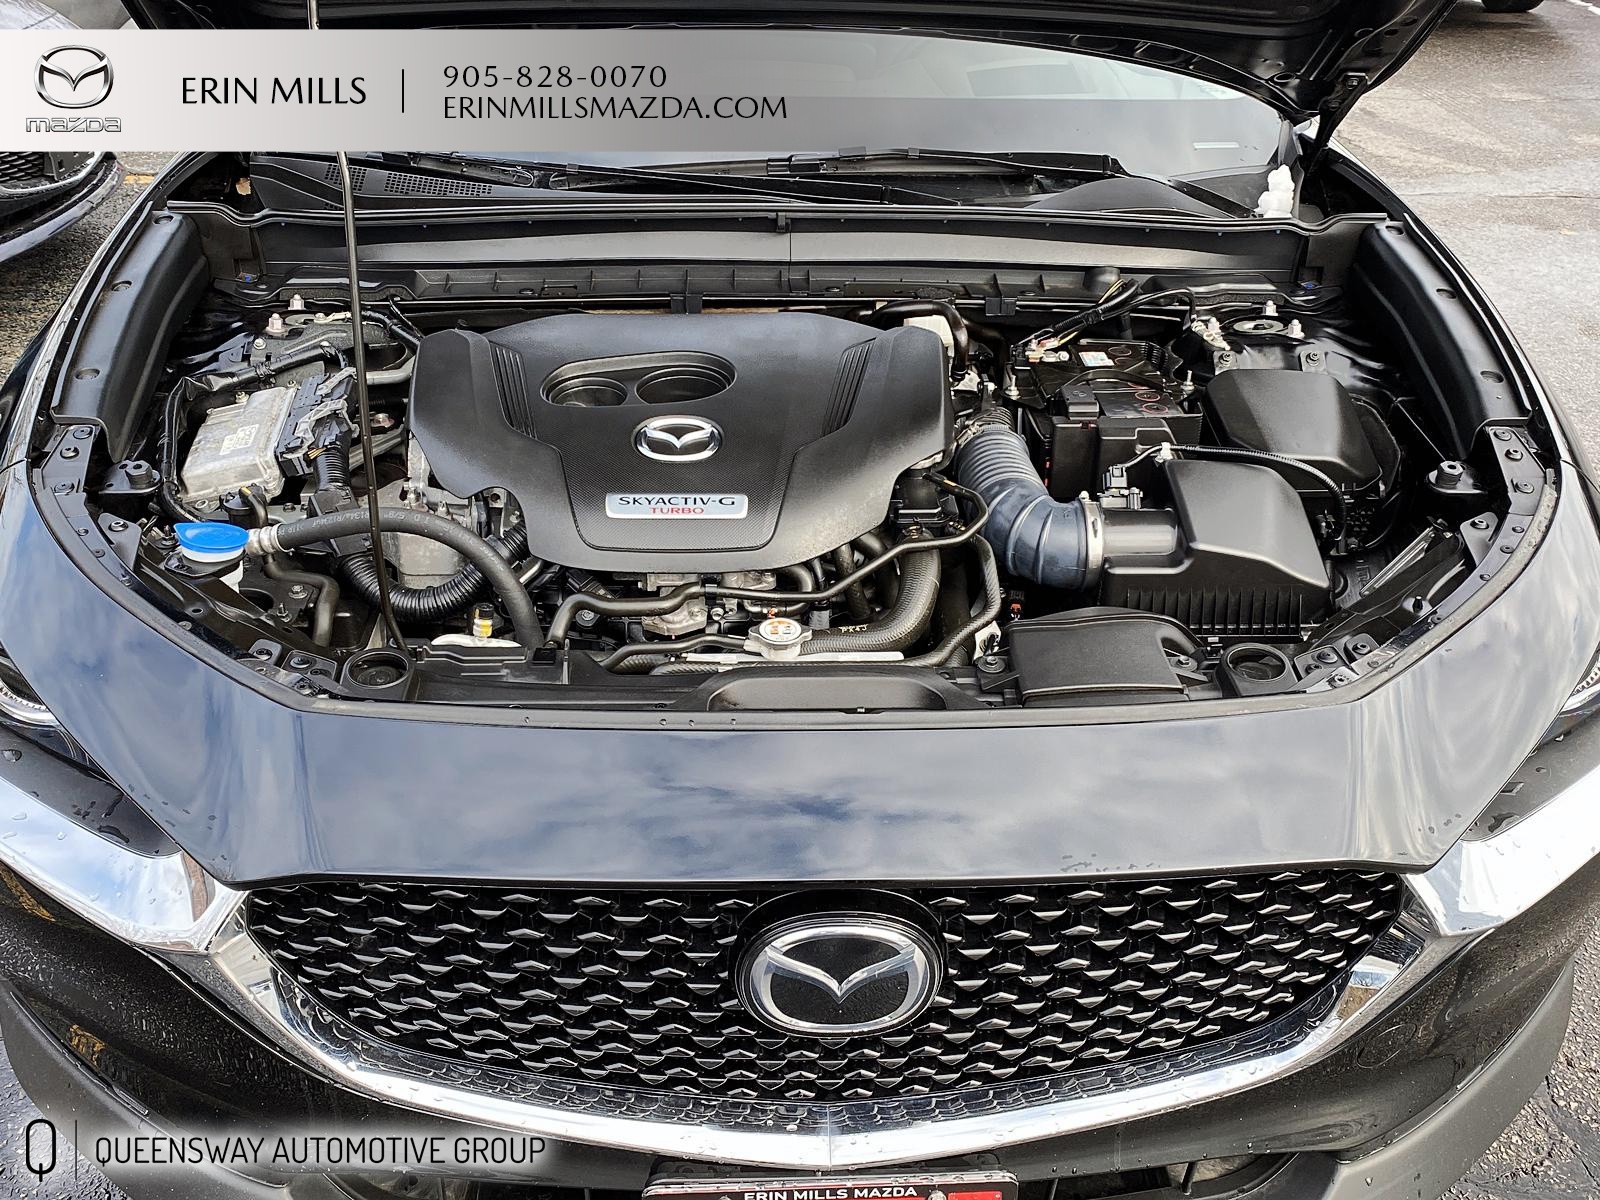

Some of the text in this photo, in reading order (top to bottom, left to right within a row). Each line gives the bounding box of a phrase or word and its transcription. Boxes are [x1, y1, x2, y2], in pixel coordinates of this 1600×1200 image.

[618, 496, 735, 506] SKYACTIV-G
[744, 1187, 918, 1200] ERIN MILLS MAZDA
